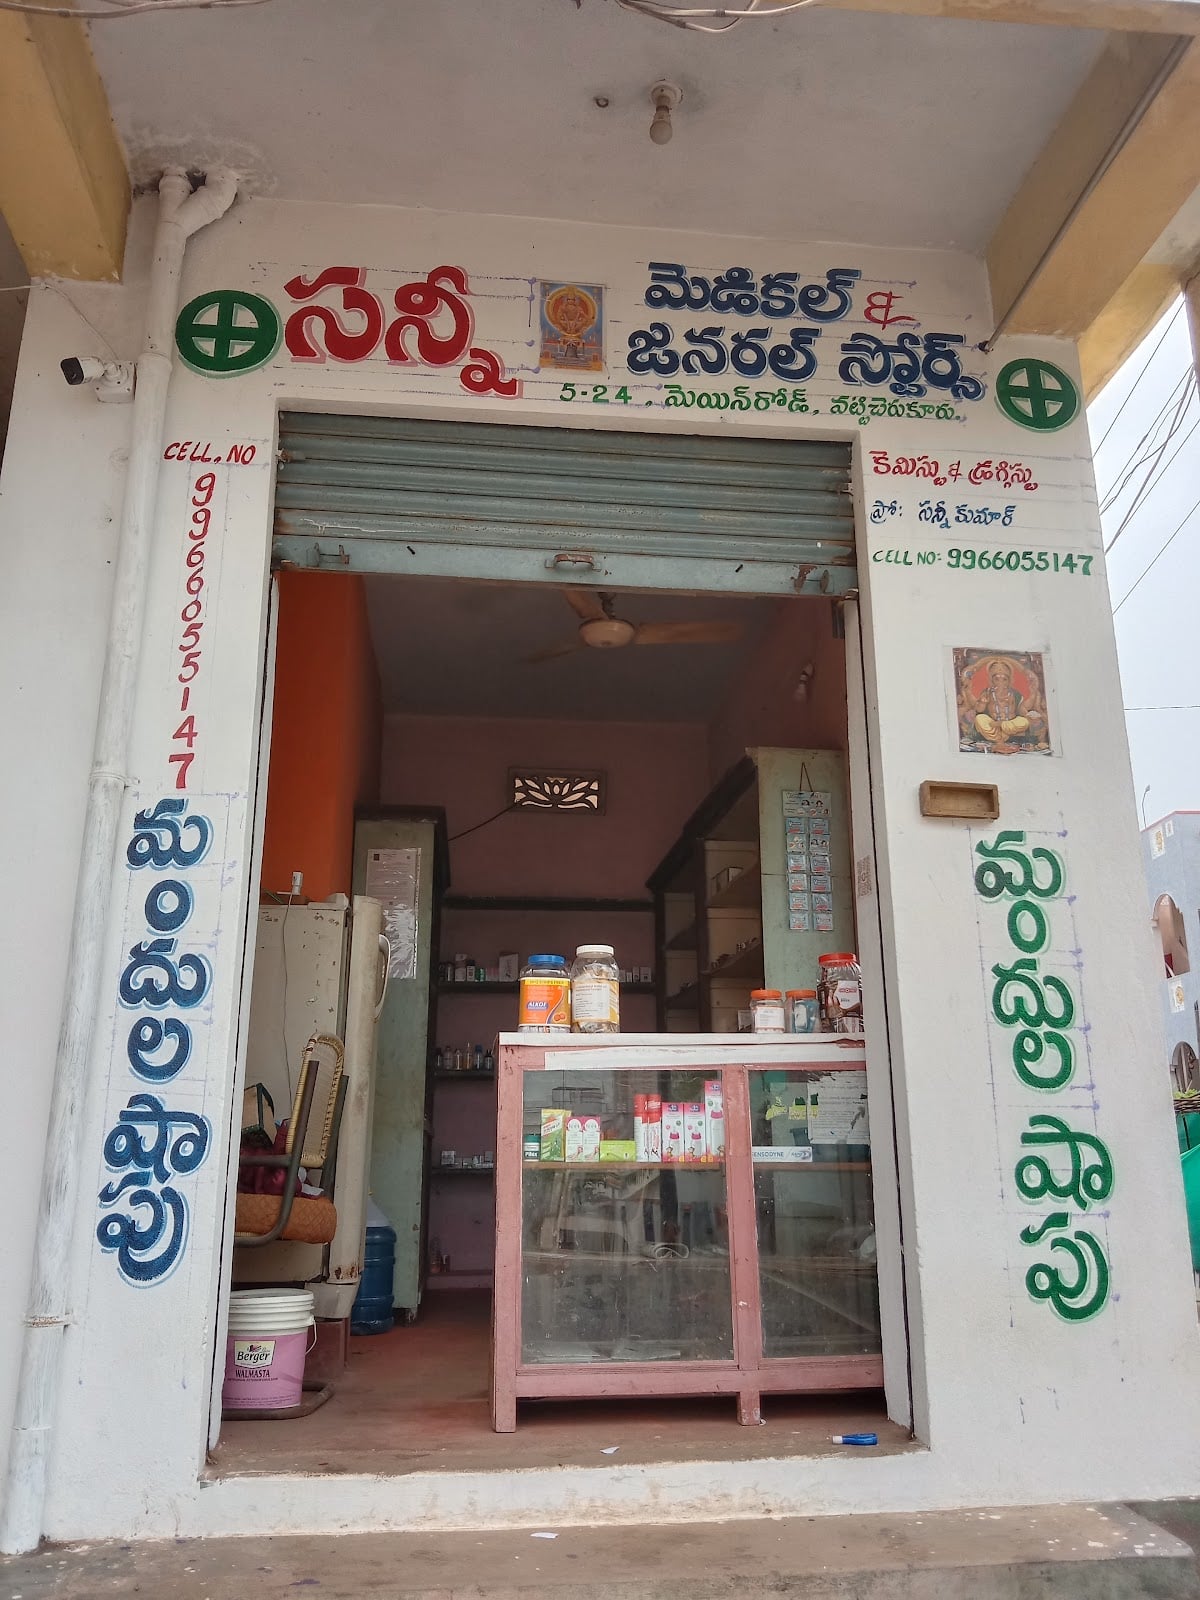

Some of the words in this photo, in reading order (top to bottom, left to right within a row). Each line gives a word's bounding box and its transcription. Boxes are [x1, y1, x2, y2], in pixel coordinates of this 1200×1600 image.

[645, 262, 861, 323] మెడికల్
[863, 289, 916, 331] &
[284, 265, 520, 398] సన్నీ
[869, 450, 947, 487] కెమిస్టు
[954, 504, 1017, 527] కుమార్
[872, 549, 913, 567] CELL
[946, 548, 1094, 577] 9966055147
[168, 472, 217, 790] 9966055147
[237, 1350, 271, 1364] Berger
